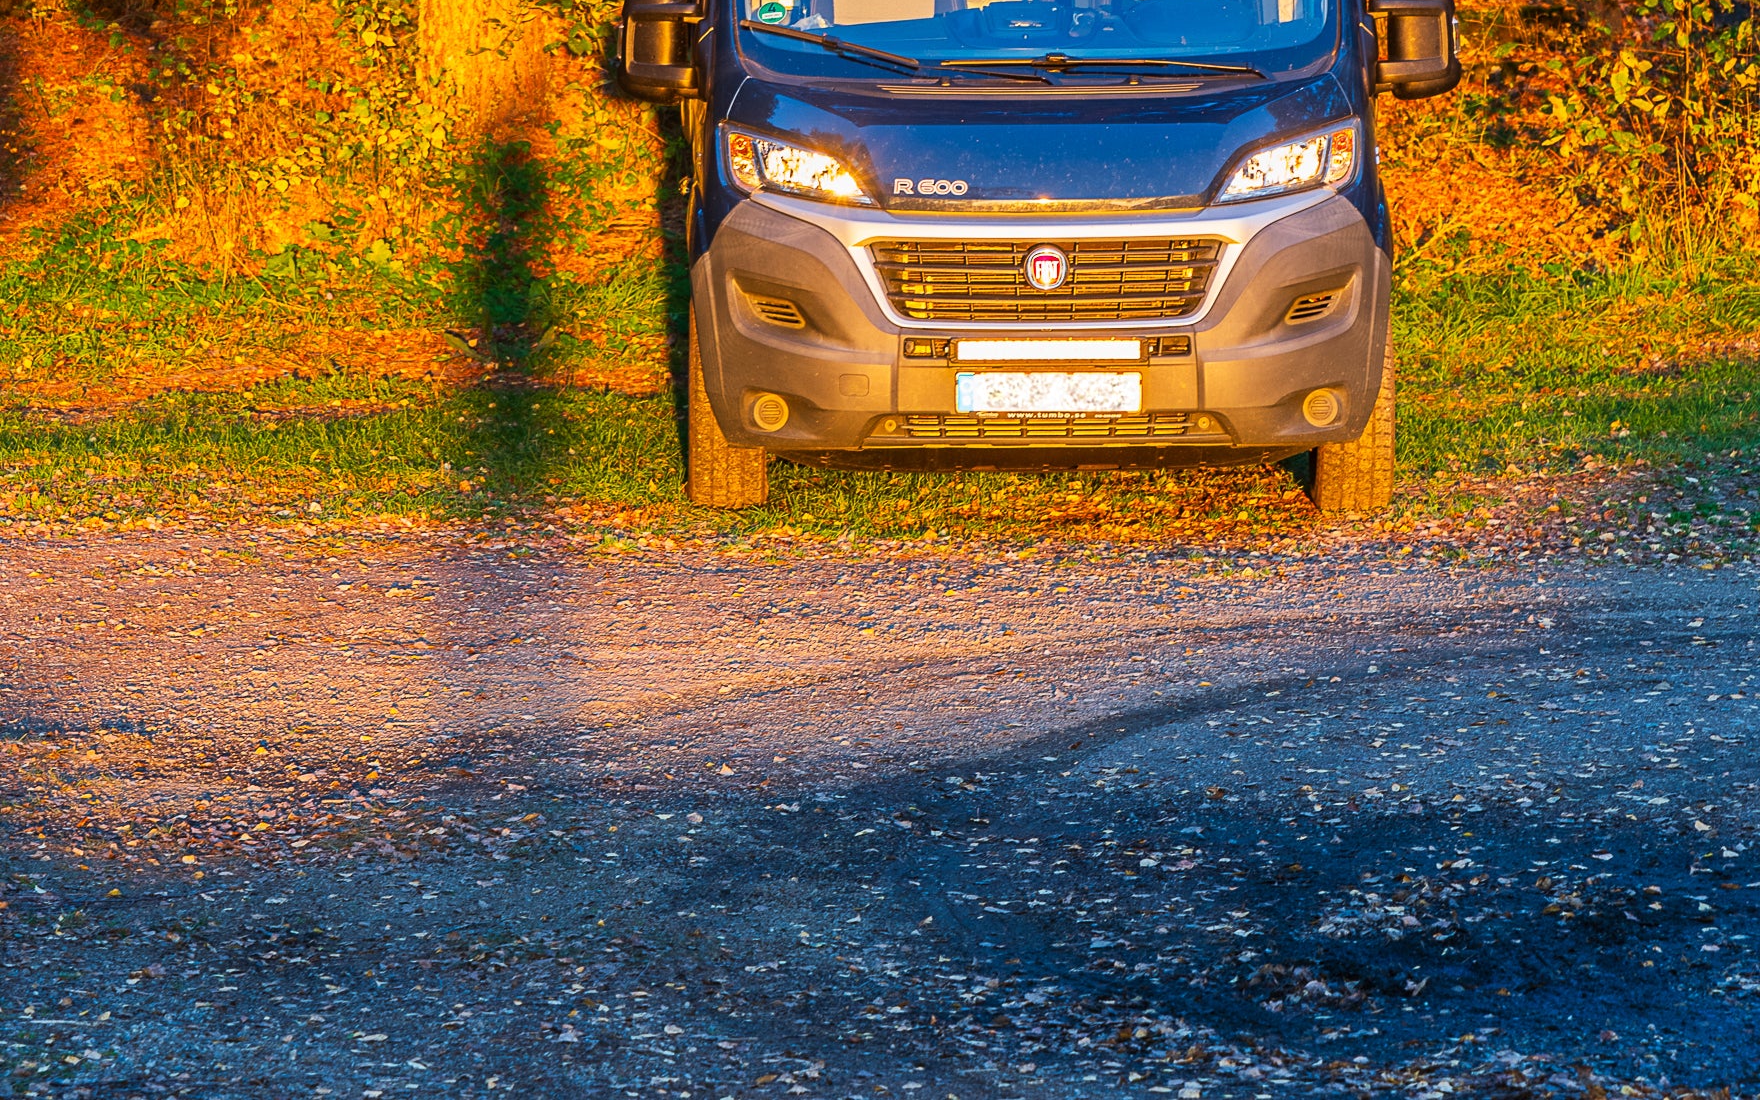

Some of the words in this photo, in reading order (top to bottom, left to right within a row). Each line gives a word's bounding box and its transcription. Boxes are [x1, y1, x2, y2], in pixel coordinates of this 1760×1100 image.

[768, 2, 776, 13] 4
[893, 178, 914, 195] R
[917, 179, 969, 196] 600
[1035, 260, 1060, 281] FIAT
[1007, 411, 1087, 419] www.tumbo.se
